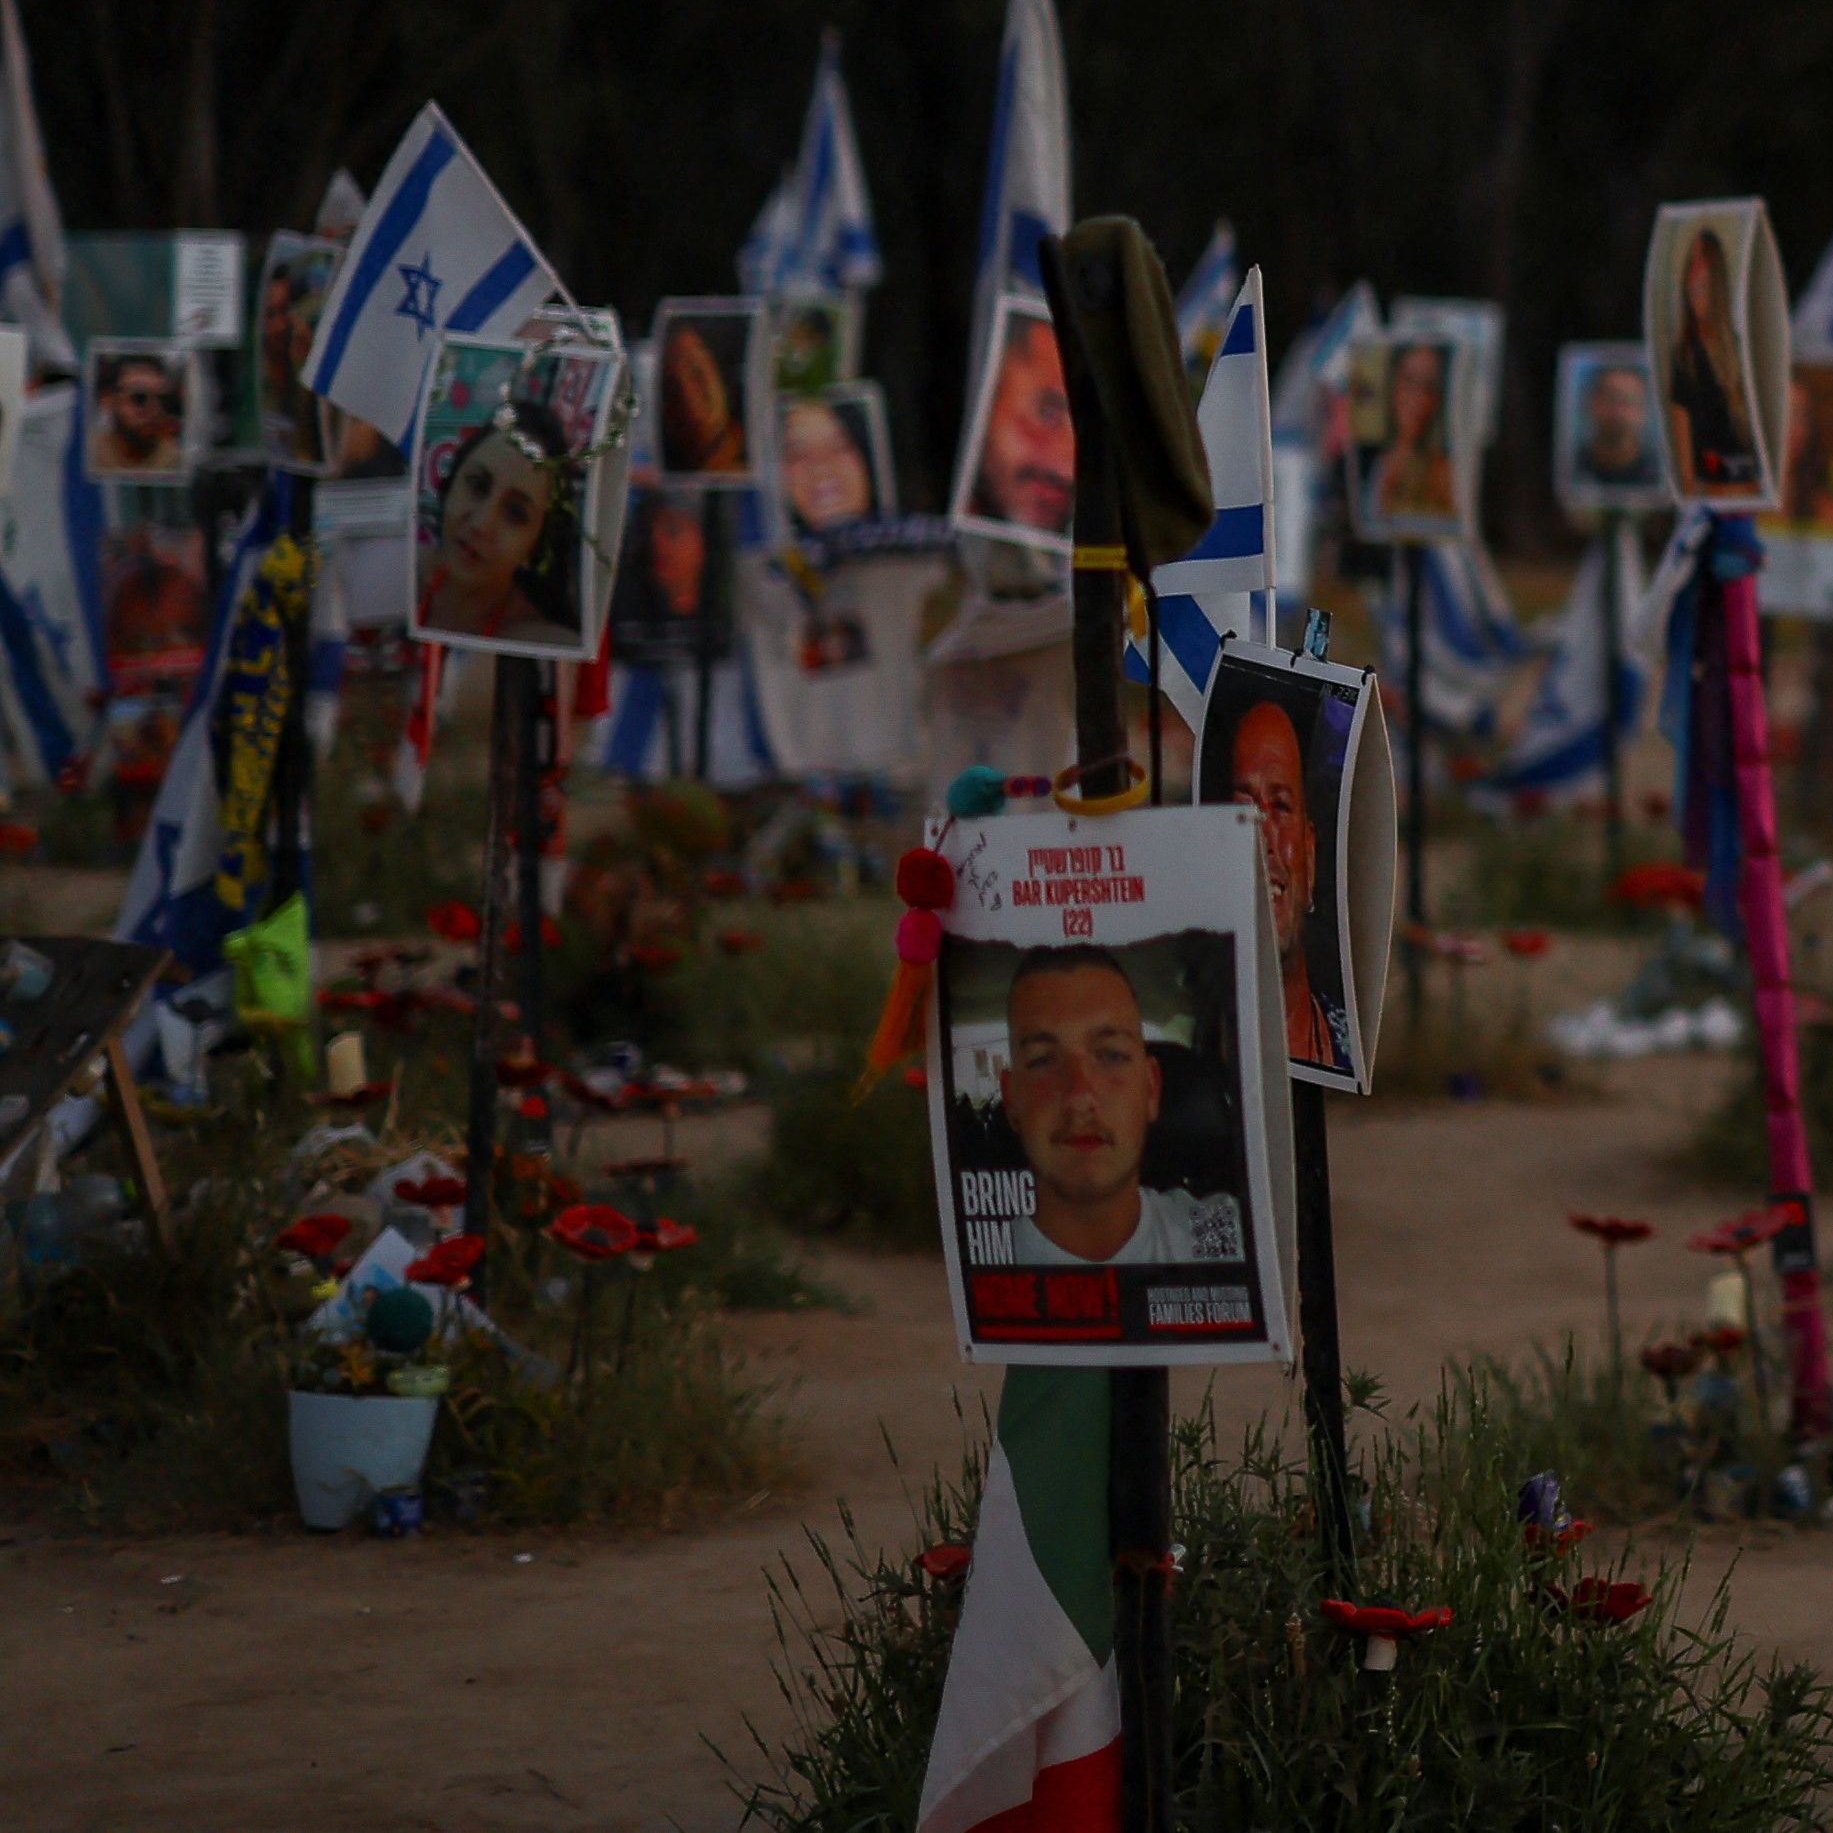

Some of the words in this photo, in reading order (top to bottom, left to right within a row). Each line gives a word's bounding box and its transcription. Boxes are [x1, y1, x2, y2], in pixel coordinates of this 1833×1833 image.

[1106, 845, 1125, 872] בר
[1012, 879, 1042, 906] BAR
[1046, 876, 1145, 904] KUPERSHTEIN
[1062, 907, 1093, 937] (22)
[960, 1169, 1036, 1216] BRING
[965, 1219, 1015, 1265] HIM
[1149, 1303, 1204, 1325] FAMILIES
[1206, 1302, 1252, 1324] FORUM
